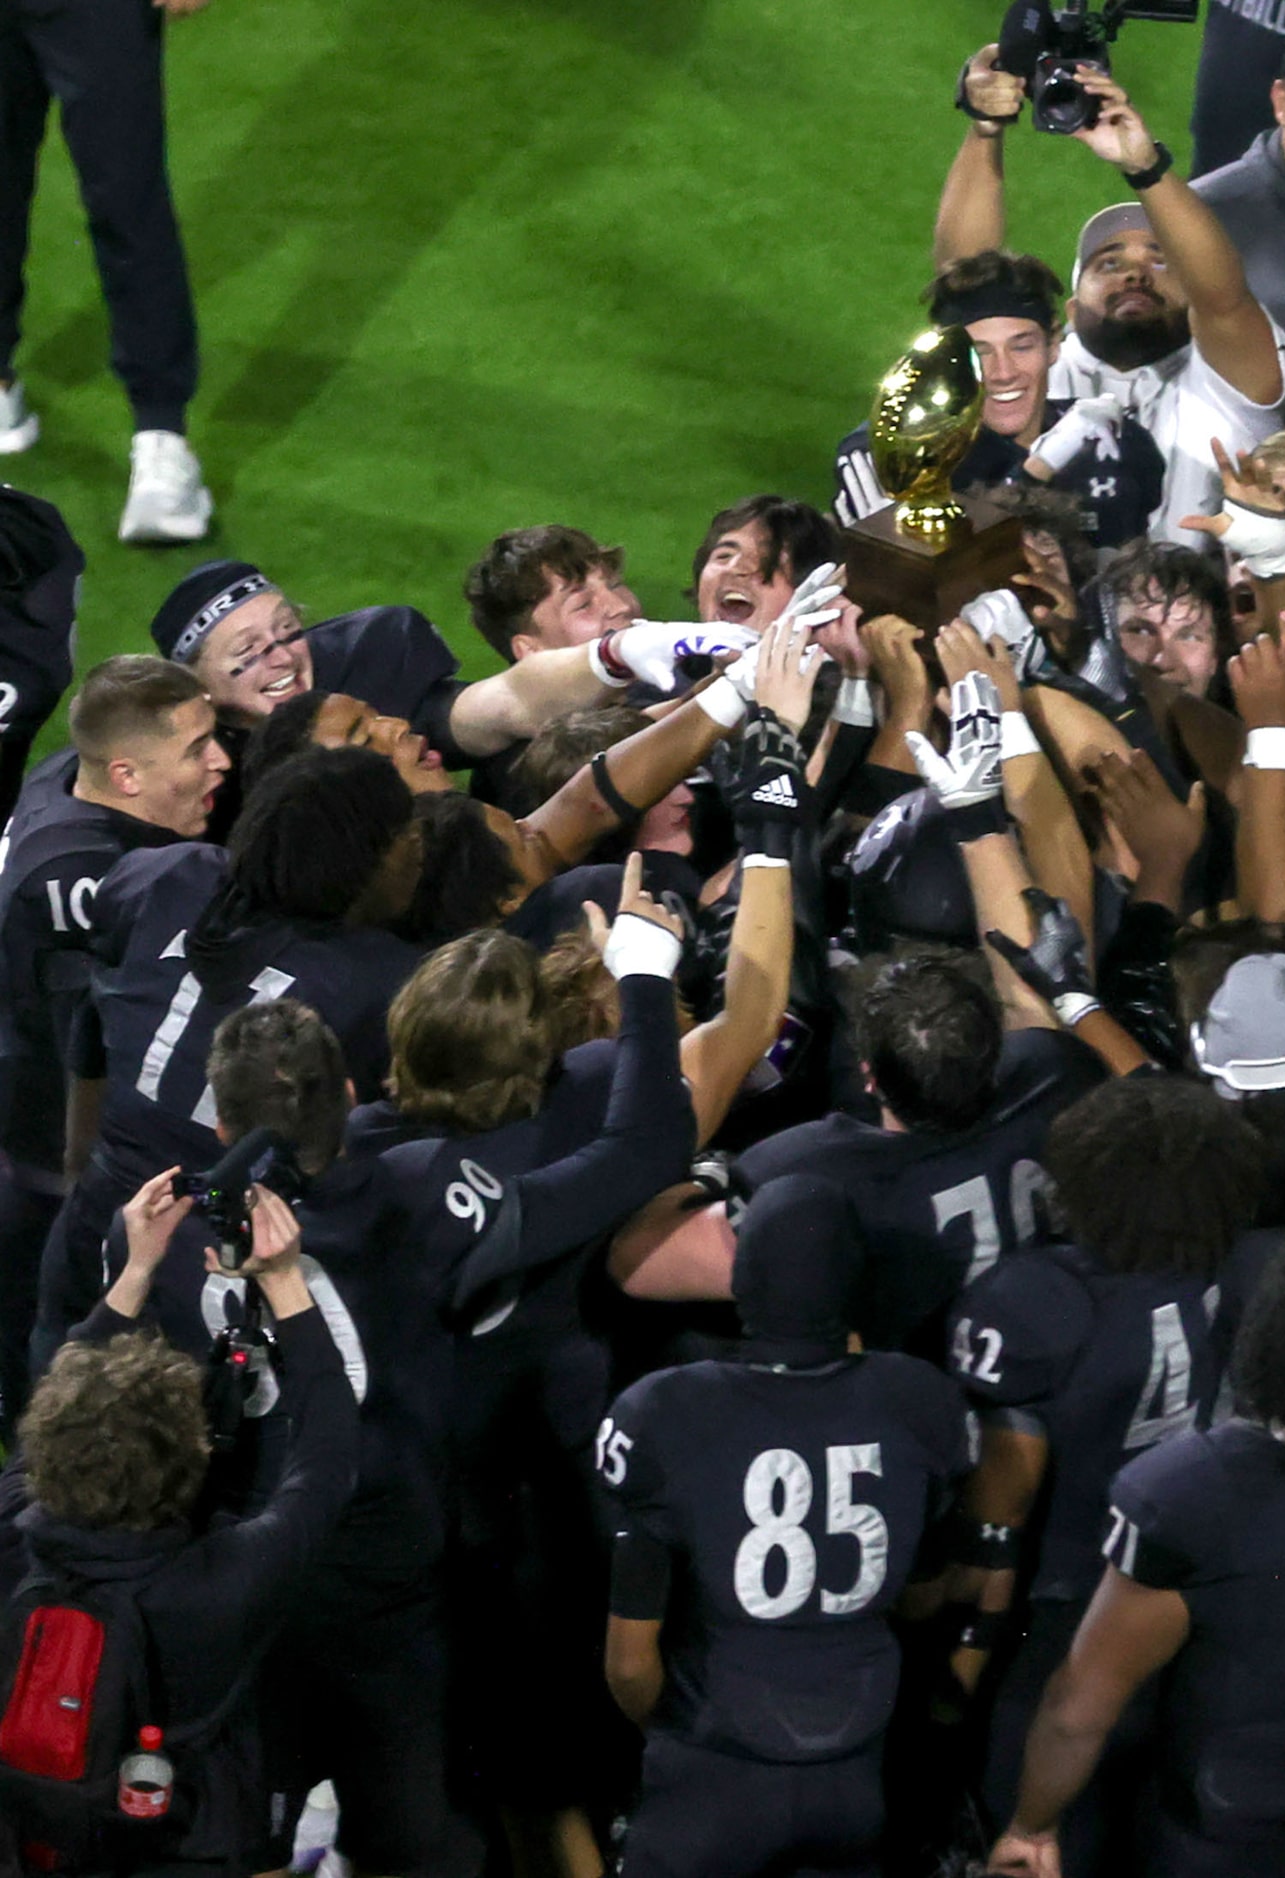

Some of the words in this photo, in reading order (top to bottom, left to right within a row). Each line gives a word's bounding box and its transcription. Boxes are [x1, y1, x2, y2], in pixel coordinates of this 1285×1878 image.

[445, 1158, 503, 1233] 90
[951, 1317, 1003, 1384] 42
[734, 1442, 889, 1620] 85
